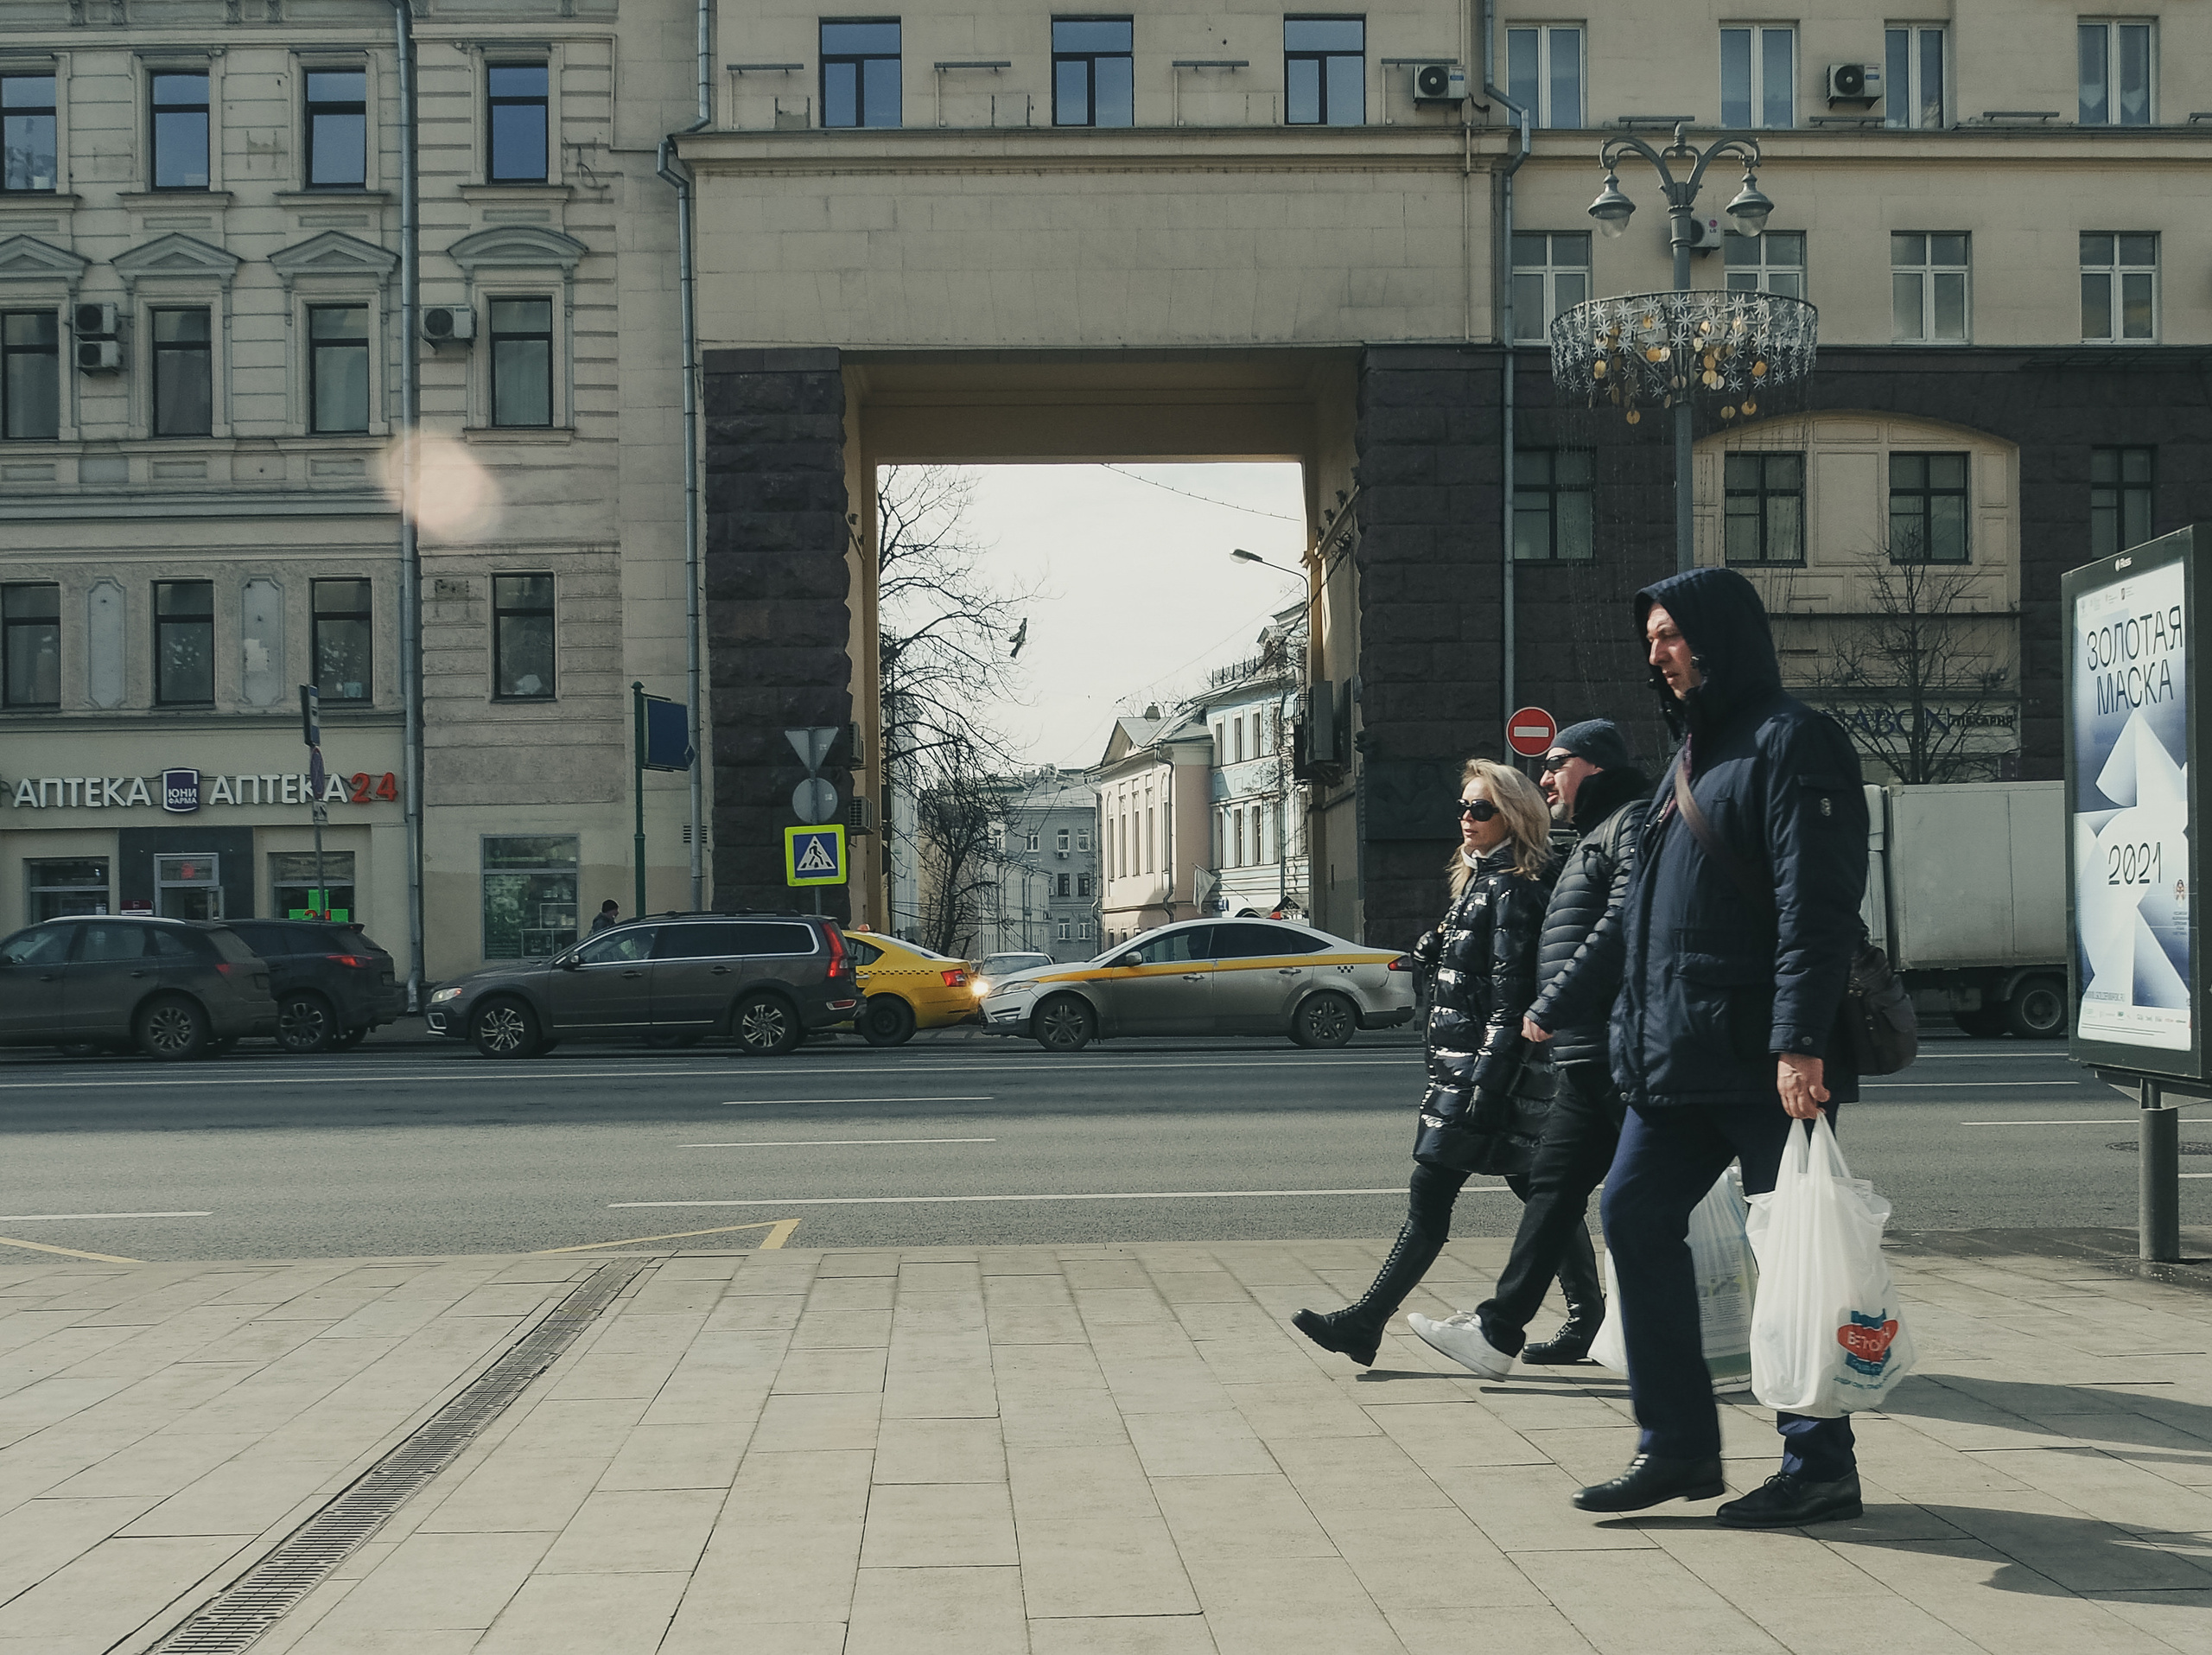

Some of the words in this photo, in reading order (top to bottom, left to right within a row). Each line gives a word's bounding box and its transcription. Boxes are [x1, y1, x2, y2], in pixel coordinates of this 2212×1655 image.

[2087, 605, 2183, 672] ЗОЛОТАЯ
[2096, 659, 2174, 716] МАСКА
[13, 776, 152, 808] АПТЕКА
[168, 788, 197, 798] ЮНИ
[209, 773, 348, 805] АПТЕКА
[351, 772, 398, 803] 24
[2107, 842, 2162, 885] 2021
